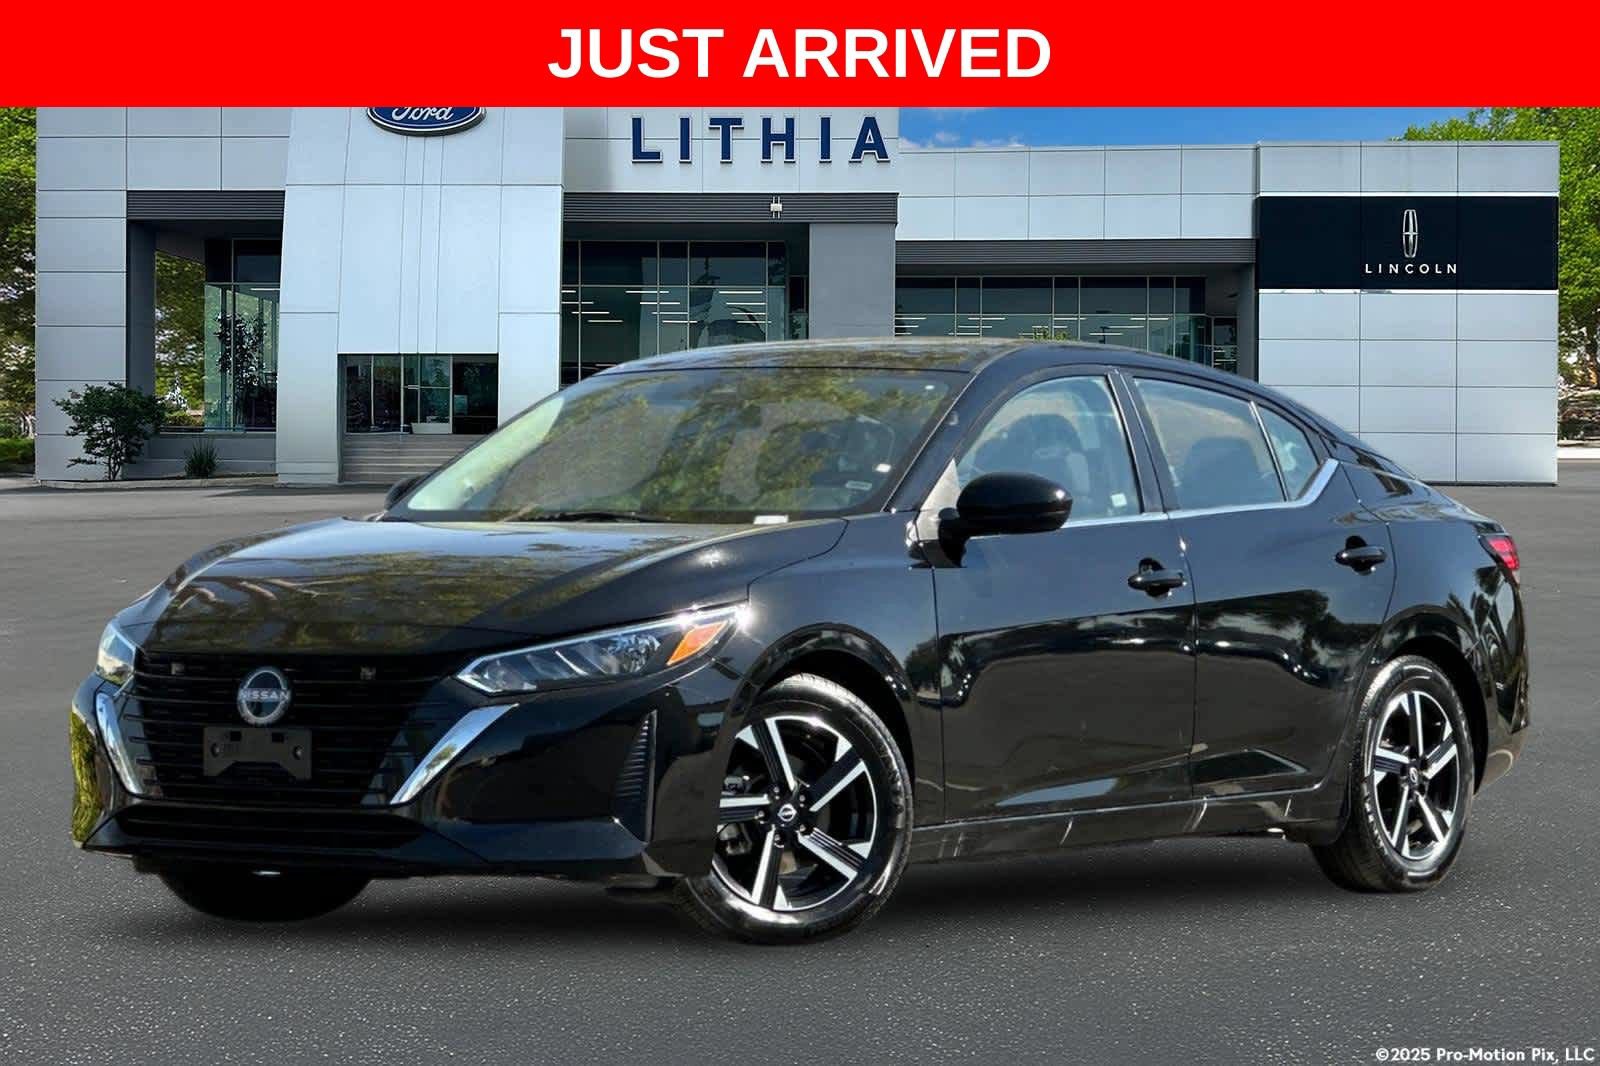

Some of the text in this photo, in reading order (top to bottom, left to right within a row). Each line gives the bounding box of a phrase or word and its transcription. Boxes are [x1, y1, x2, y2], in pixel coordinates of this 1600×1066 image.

[631, 116, 891, 163] LITHIA
[1365, 263, 1457, 274] LINCOLN
[239, 689, 290, 700] NISSAN
